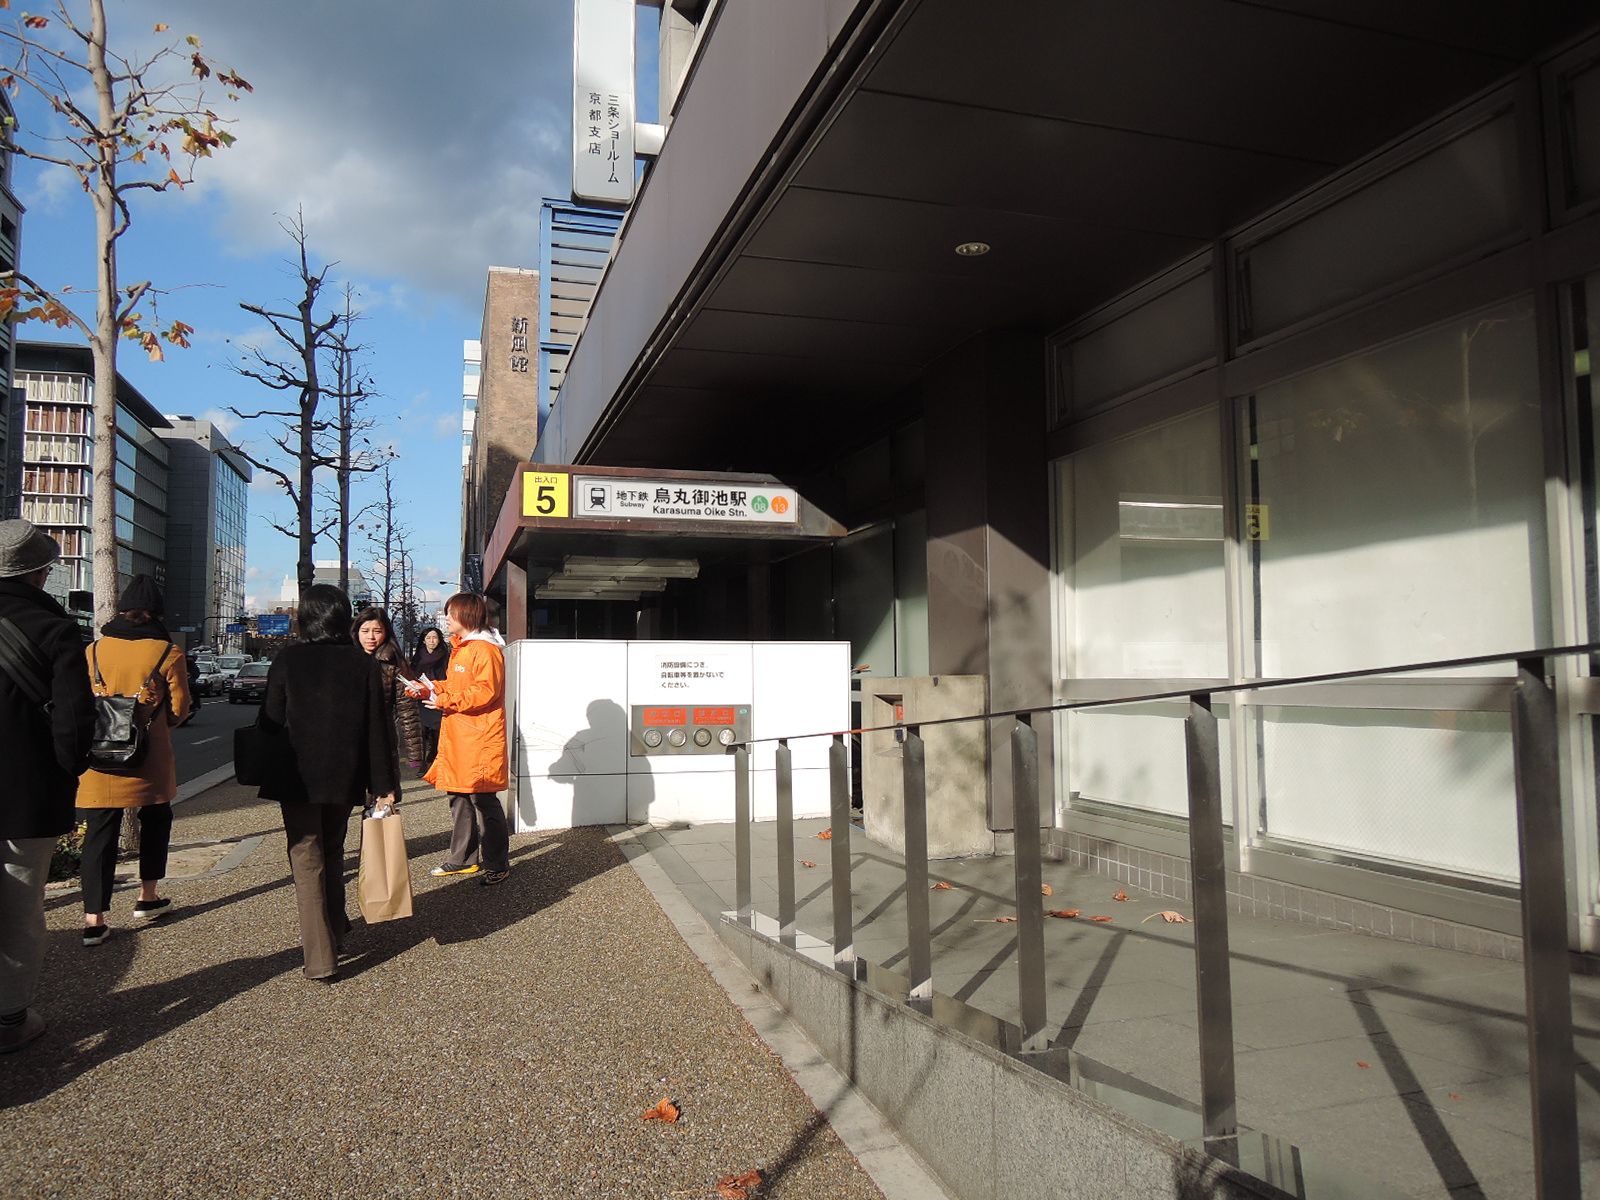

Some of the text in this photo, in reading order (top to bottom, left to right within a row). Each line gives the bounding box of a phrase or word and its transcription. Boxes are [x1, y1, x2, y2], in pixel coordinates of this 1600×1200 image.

[589, 92, 602, 155] 京都支店
[607, 94, 620, 184] 三条ショールーム
[534, 475, 558, 484] 出入口
[535, 486, 556, 514] 5
[616, 487, 747, 507] 地下鉄 烏丸御池駅
[619, 501, 646, 509] Subway
[753, 503, 766, 512] 08
[775, 504, 786, 513] 13
[652, 506, 748, 517] Karasuma Oike Stn.
